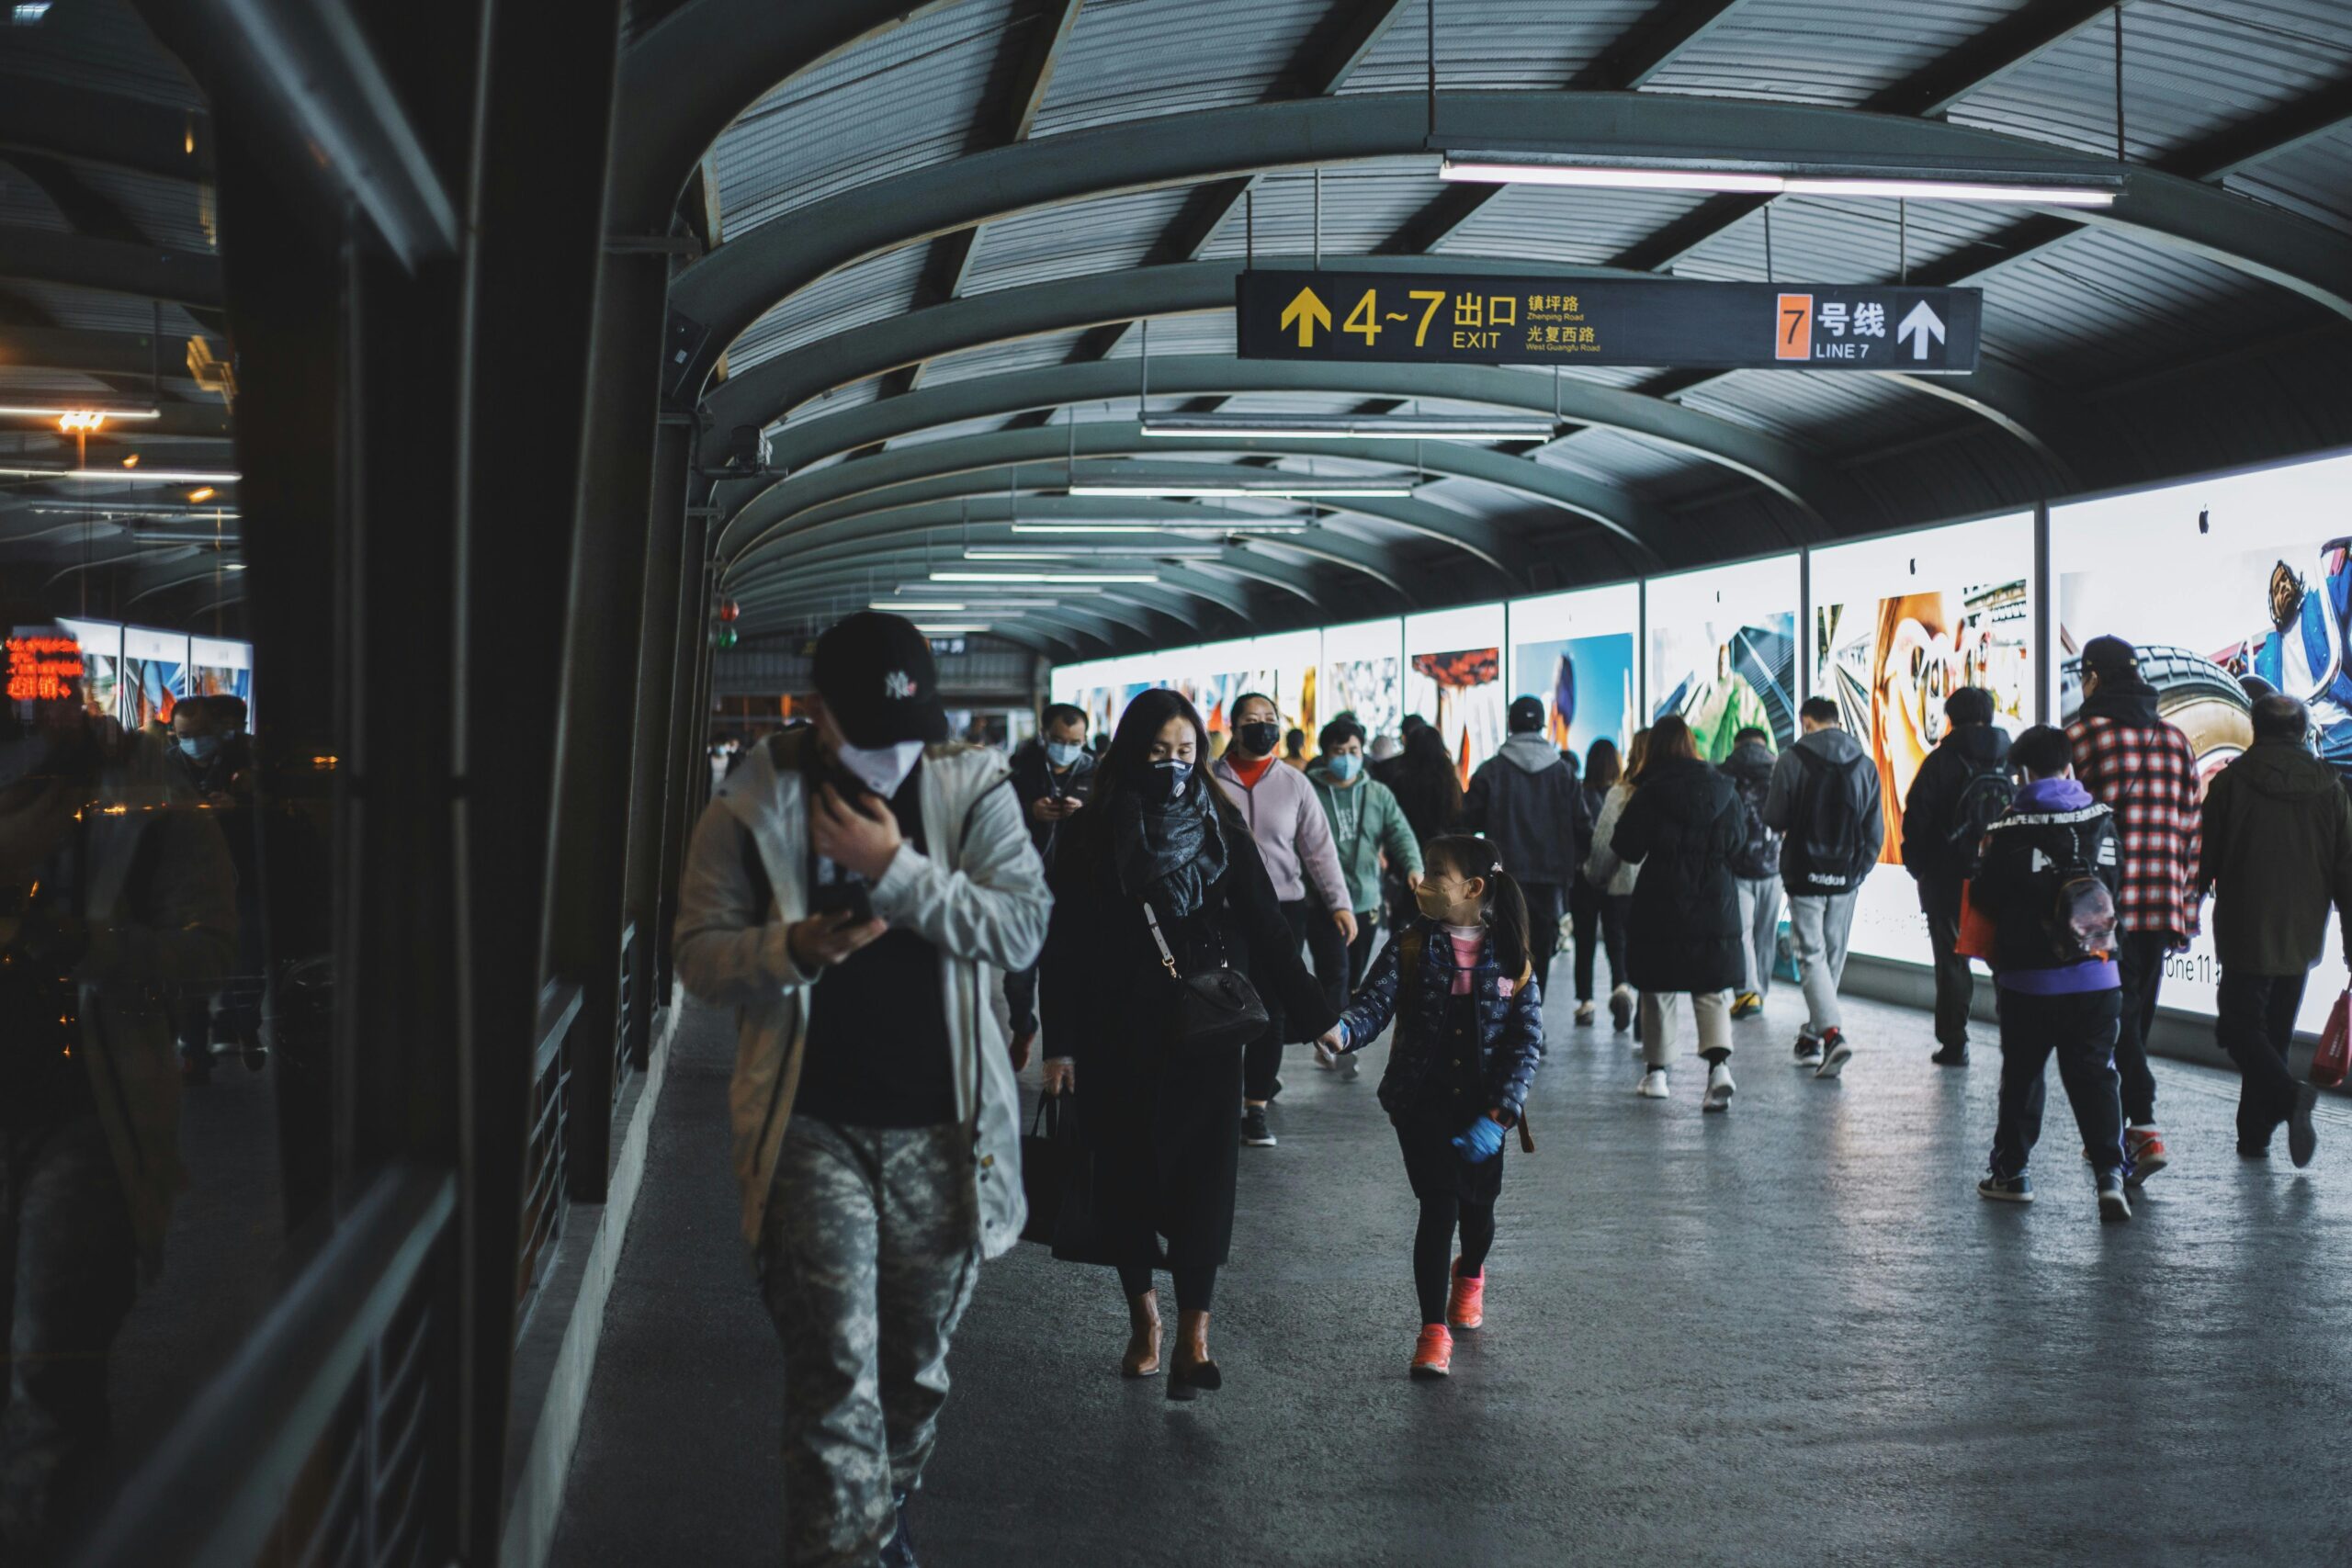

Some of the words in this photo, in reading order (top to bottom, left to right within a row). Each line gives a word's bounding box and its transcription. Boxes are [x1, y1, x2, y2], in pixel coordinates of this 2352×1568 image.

[1453, 292, 1516, 327] 出口
[1528, 295, 1579, 312] 镇坪路
[1527, 312, 1563, 321] Zhenping
[1564, 313, 1584, 321] Road
[1783, 310, 1805, 344] 7
[1817, 302, 1886, 338] 号线
[1453, 332, 1501, 348] EXIT
[1527, 325, 1595, 343] 光复西路
[1525, 343, 1545, 351] West
[1546, 344, 1578, 353] Guangfu
[1815, 344, 1855, 358] LINE
[1859, 344, 1870, 359] 7
[2165, 956, 2194, 981] one
[2198, 953, 2211, 984] 11
